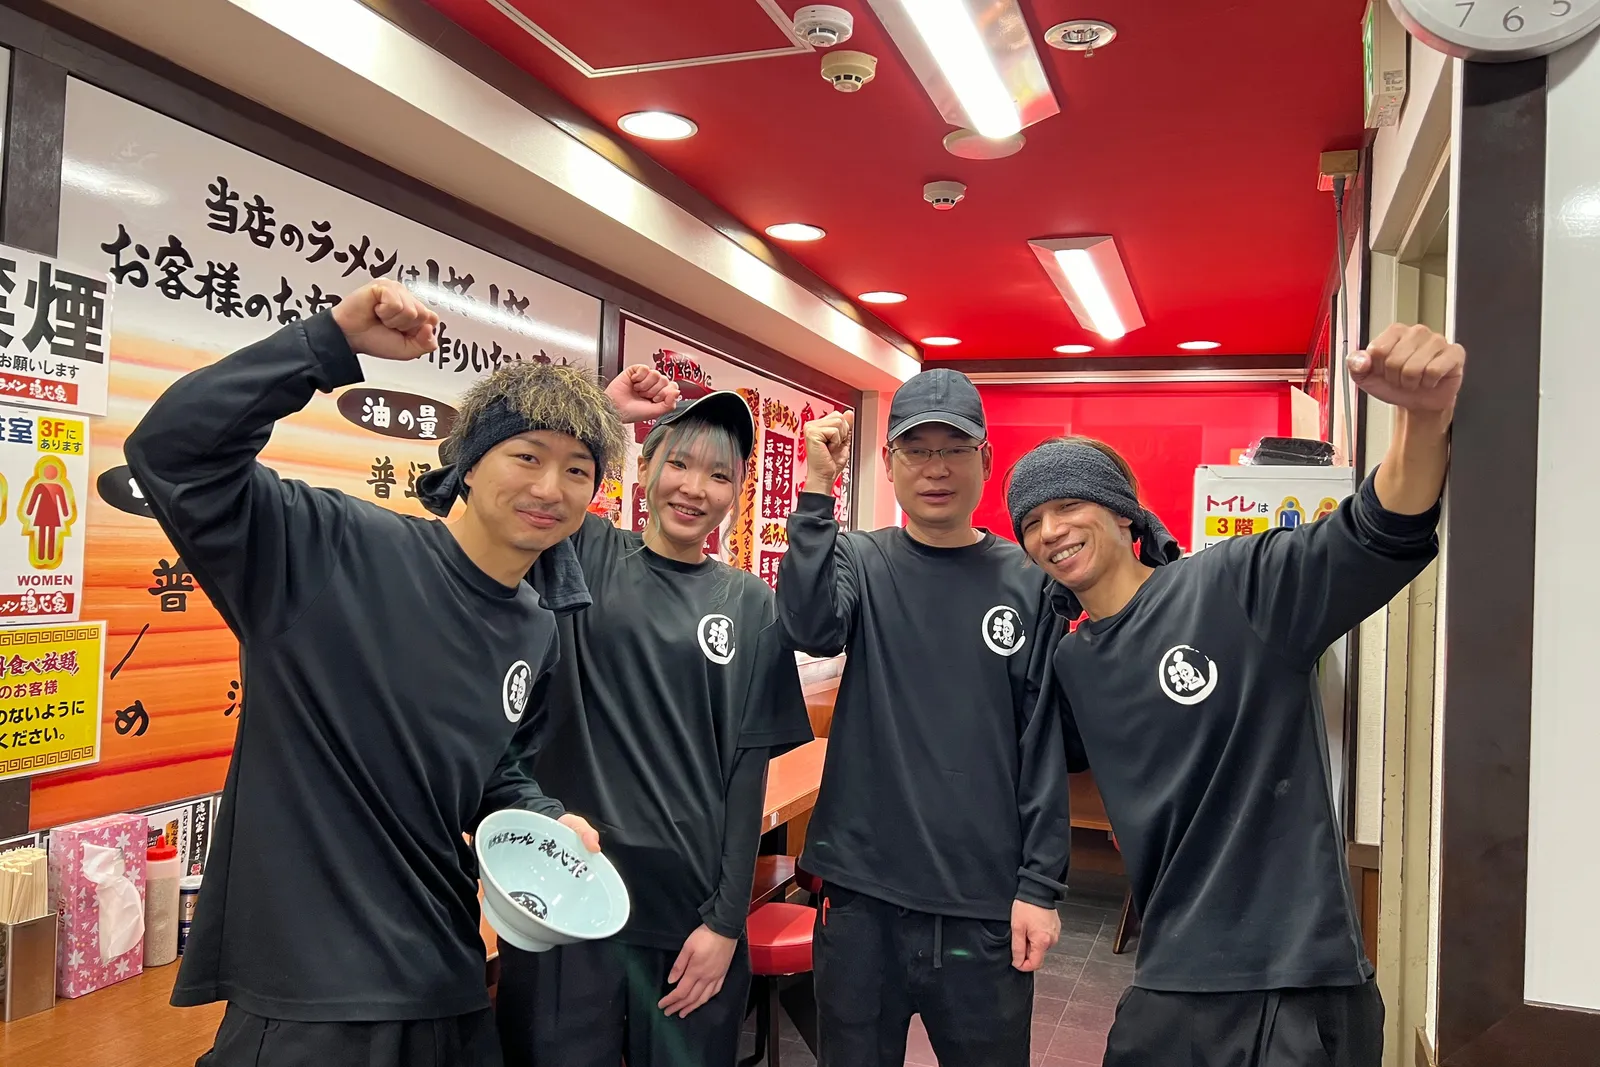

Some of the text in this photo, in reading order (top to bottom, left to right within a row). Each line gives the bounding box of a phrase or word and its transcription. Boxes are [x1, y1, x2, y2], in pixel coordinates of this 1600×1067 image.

[1455, 1, 1475, 28] 7
[1502, 6, 1525, 33] 6
[0, 257, 107, 365] 煙
[361, 396, 438, 439] 油の量
[40, 438, 83, 453] あります
[17, 575, 74, 587] WOMEN
[0, 679, 58, 699] のお客様
[115, 699, 149, 737] め
